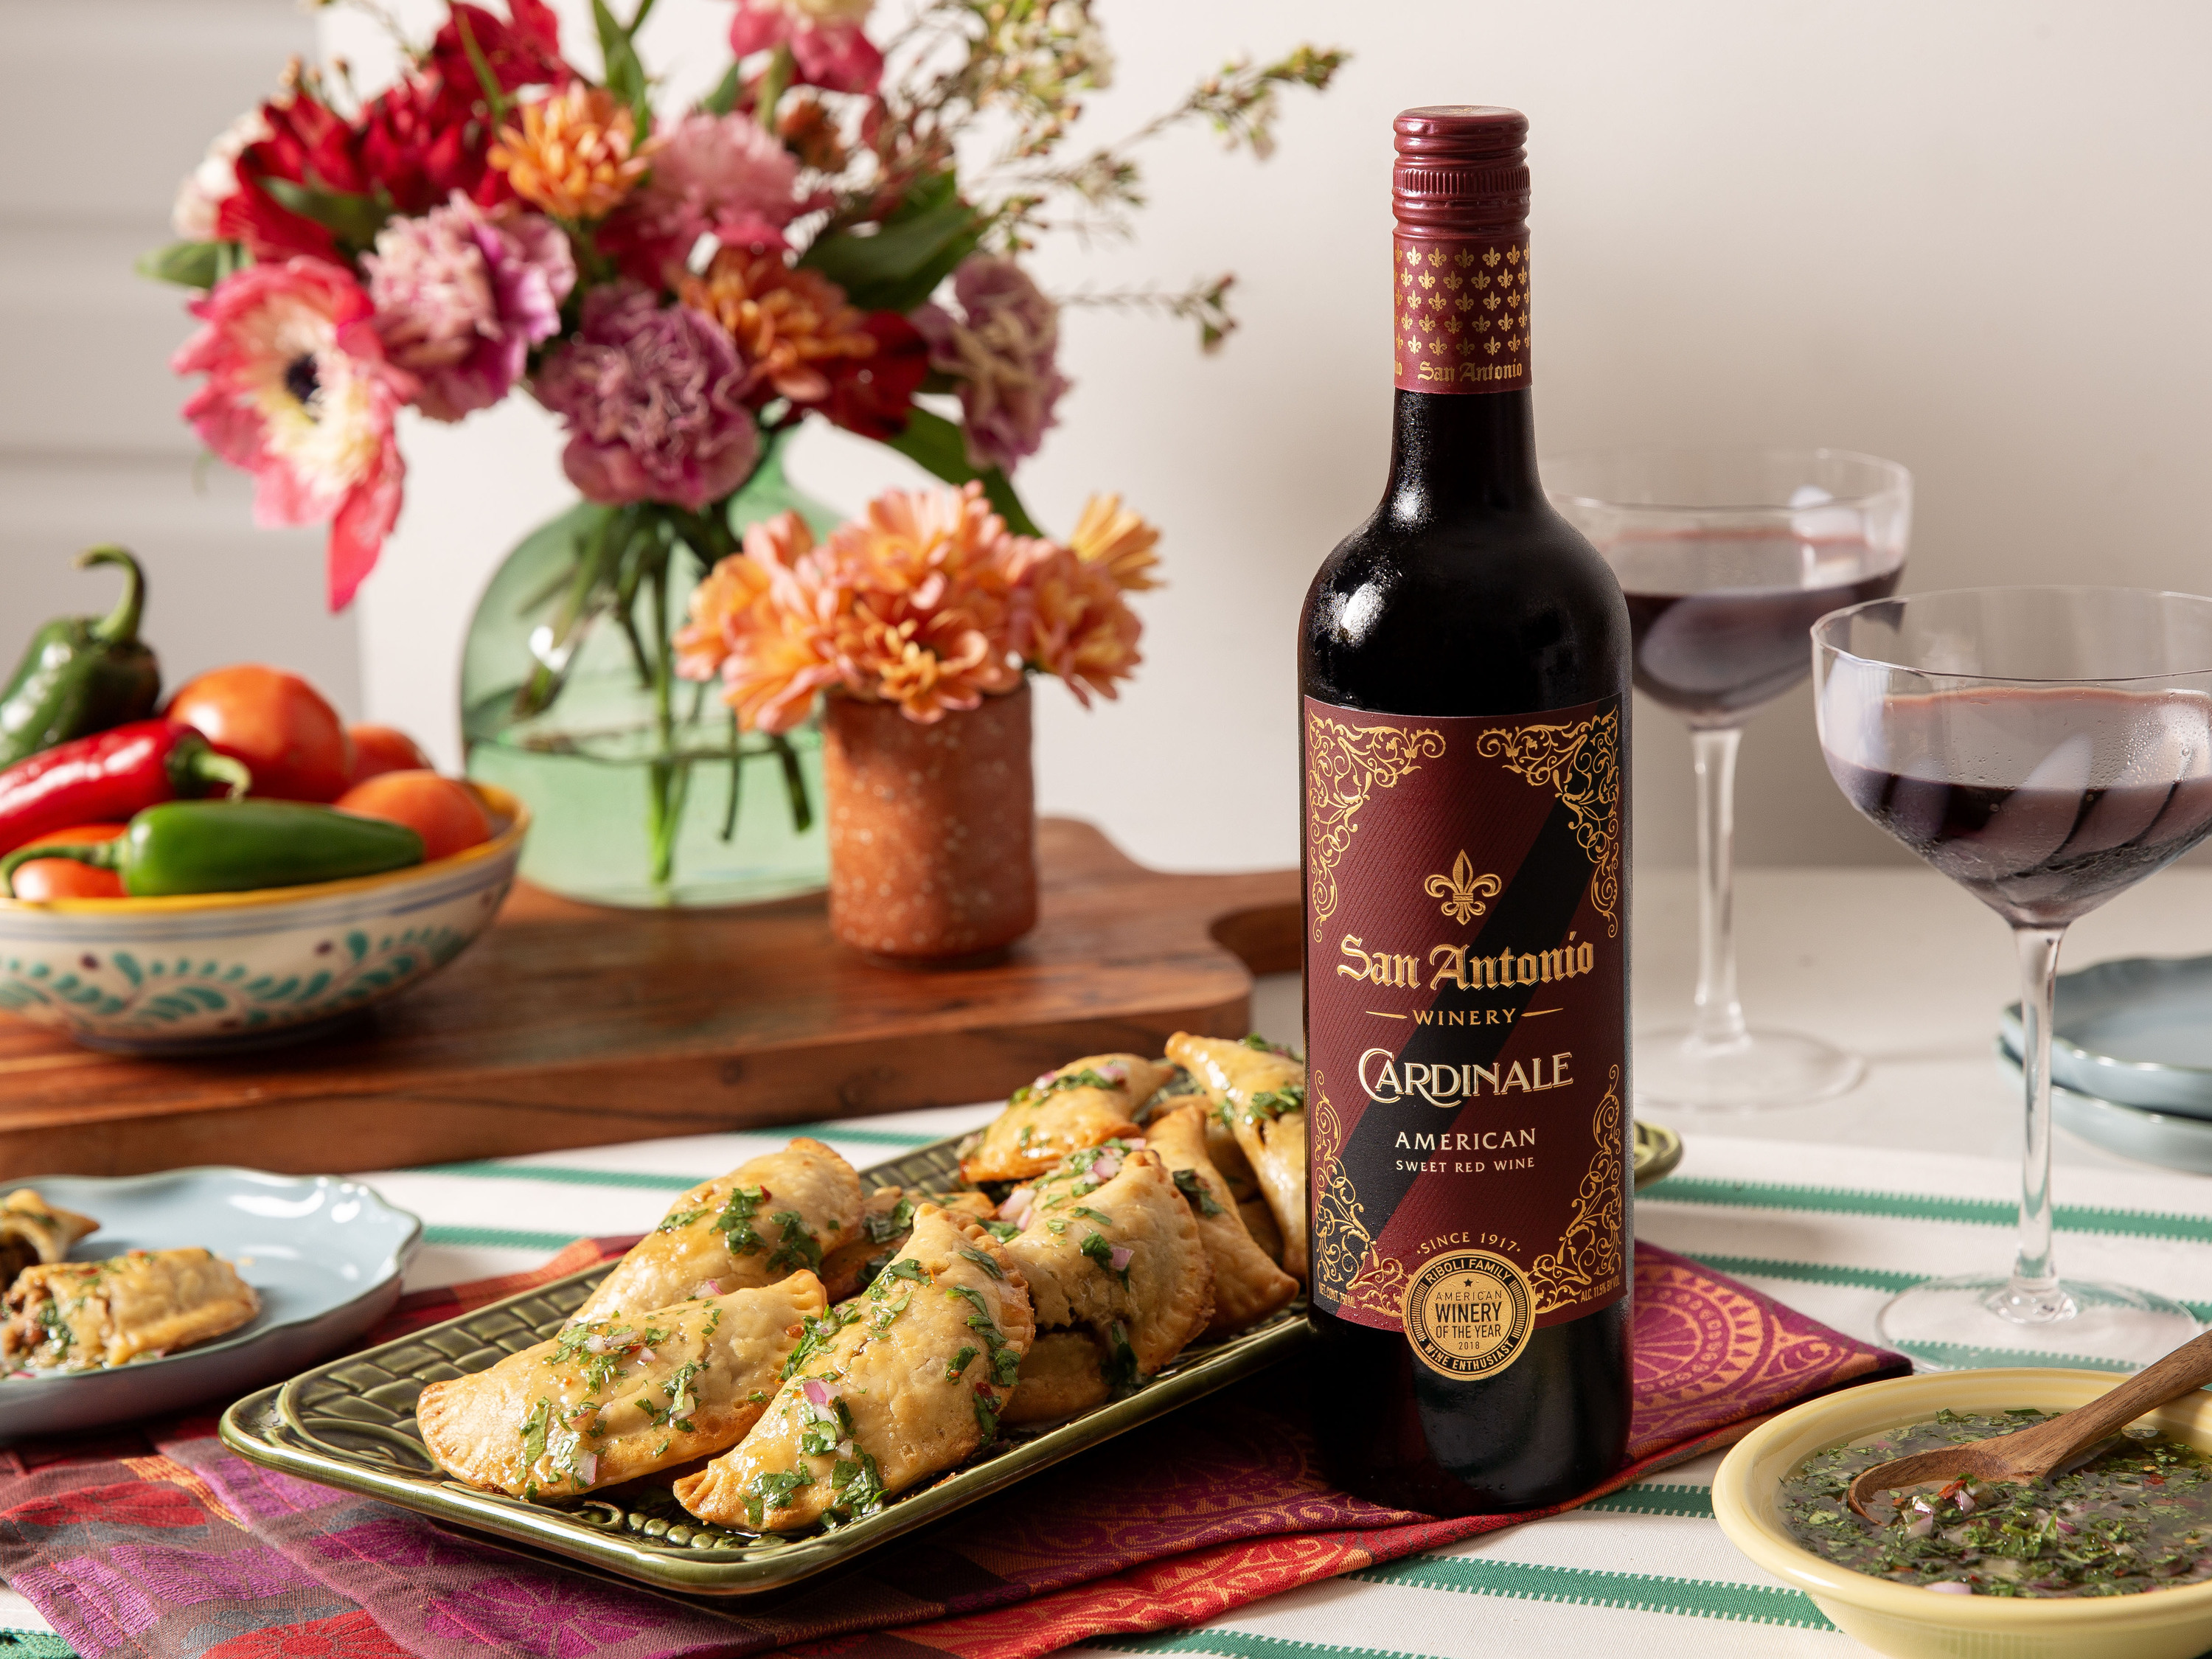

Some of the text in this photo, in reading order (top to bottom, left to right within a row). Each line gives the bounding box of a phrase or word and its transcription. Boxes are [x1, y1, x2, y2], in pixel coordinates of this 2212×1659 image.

[1417, 360, 1455, 383] San
[1459, 358, 1523, 382] Antonio
[1337, 931, 1594, 991] San Antonio
[1412, 1007, 1517, 1026] WINERY
[1358, 1047, 1574, 1107] CARDINALE
[1395, 1127, 1537, 1150] AMERICAN
[1396, 1157, 1534, 1172] SWEET RED WINE
[1420, 1231, 1470, 1254] SINCE
[1425, 1259, 1512, 1284] RIBOLI FAMILY
[1436, 1290, 1502, 1301] AMERICAN
[1580, 1288, 1593, 1303] ALC.
[1593, 1281, 1607, 1298] 11.5%
[1435, 1301, 1503, 1323] WINERY
[1436, 1324, 1501, 1338] OF THE YEAR
[1424, 1340, 1514, 1371] WINE ENTHUSIAST
[1458, 1341, 1480, 1350] 2018
